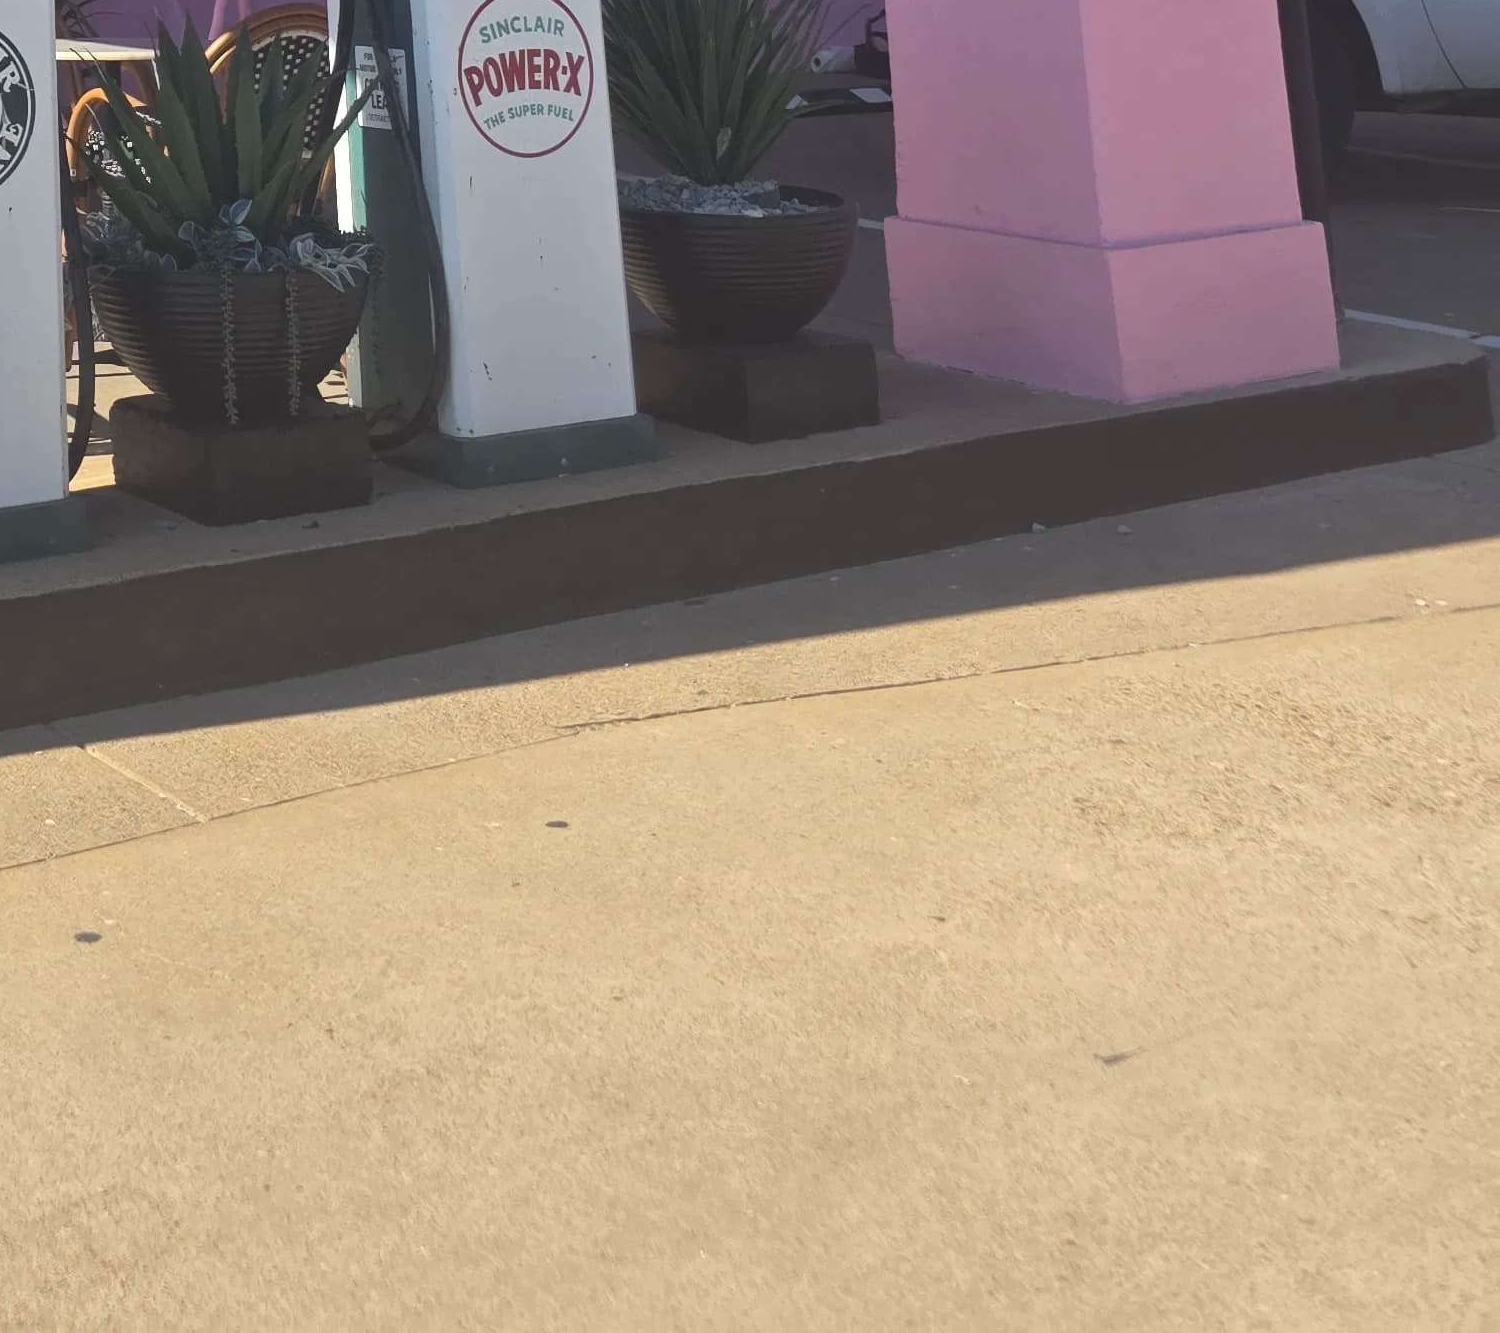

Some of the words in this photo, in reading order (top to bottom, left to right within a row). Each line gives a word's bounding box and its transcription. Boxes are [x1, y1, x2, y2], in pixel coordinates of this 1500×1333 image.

[479, 15, 565, 44] SINCLAIR
[483, 110, 506, 130] THE
[507, 103, 545, 122] SUPER
[547, 104, 575, 122] FUEL
